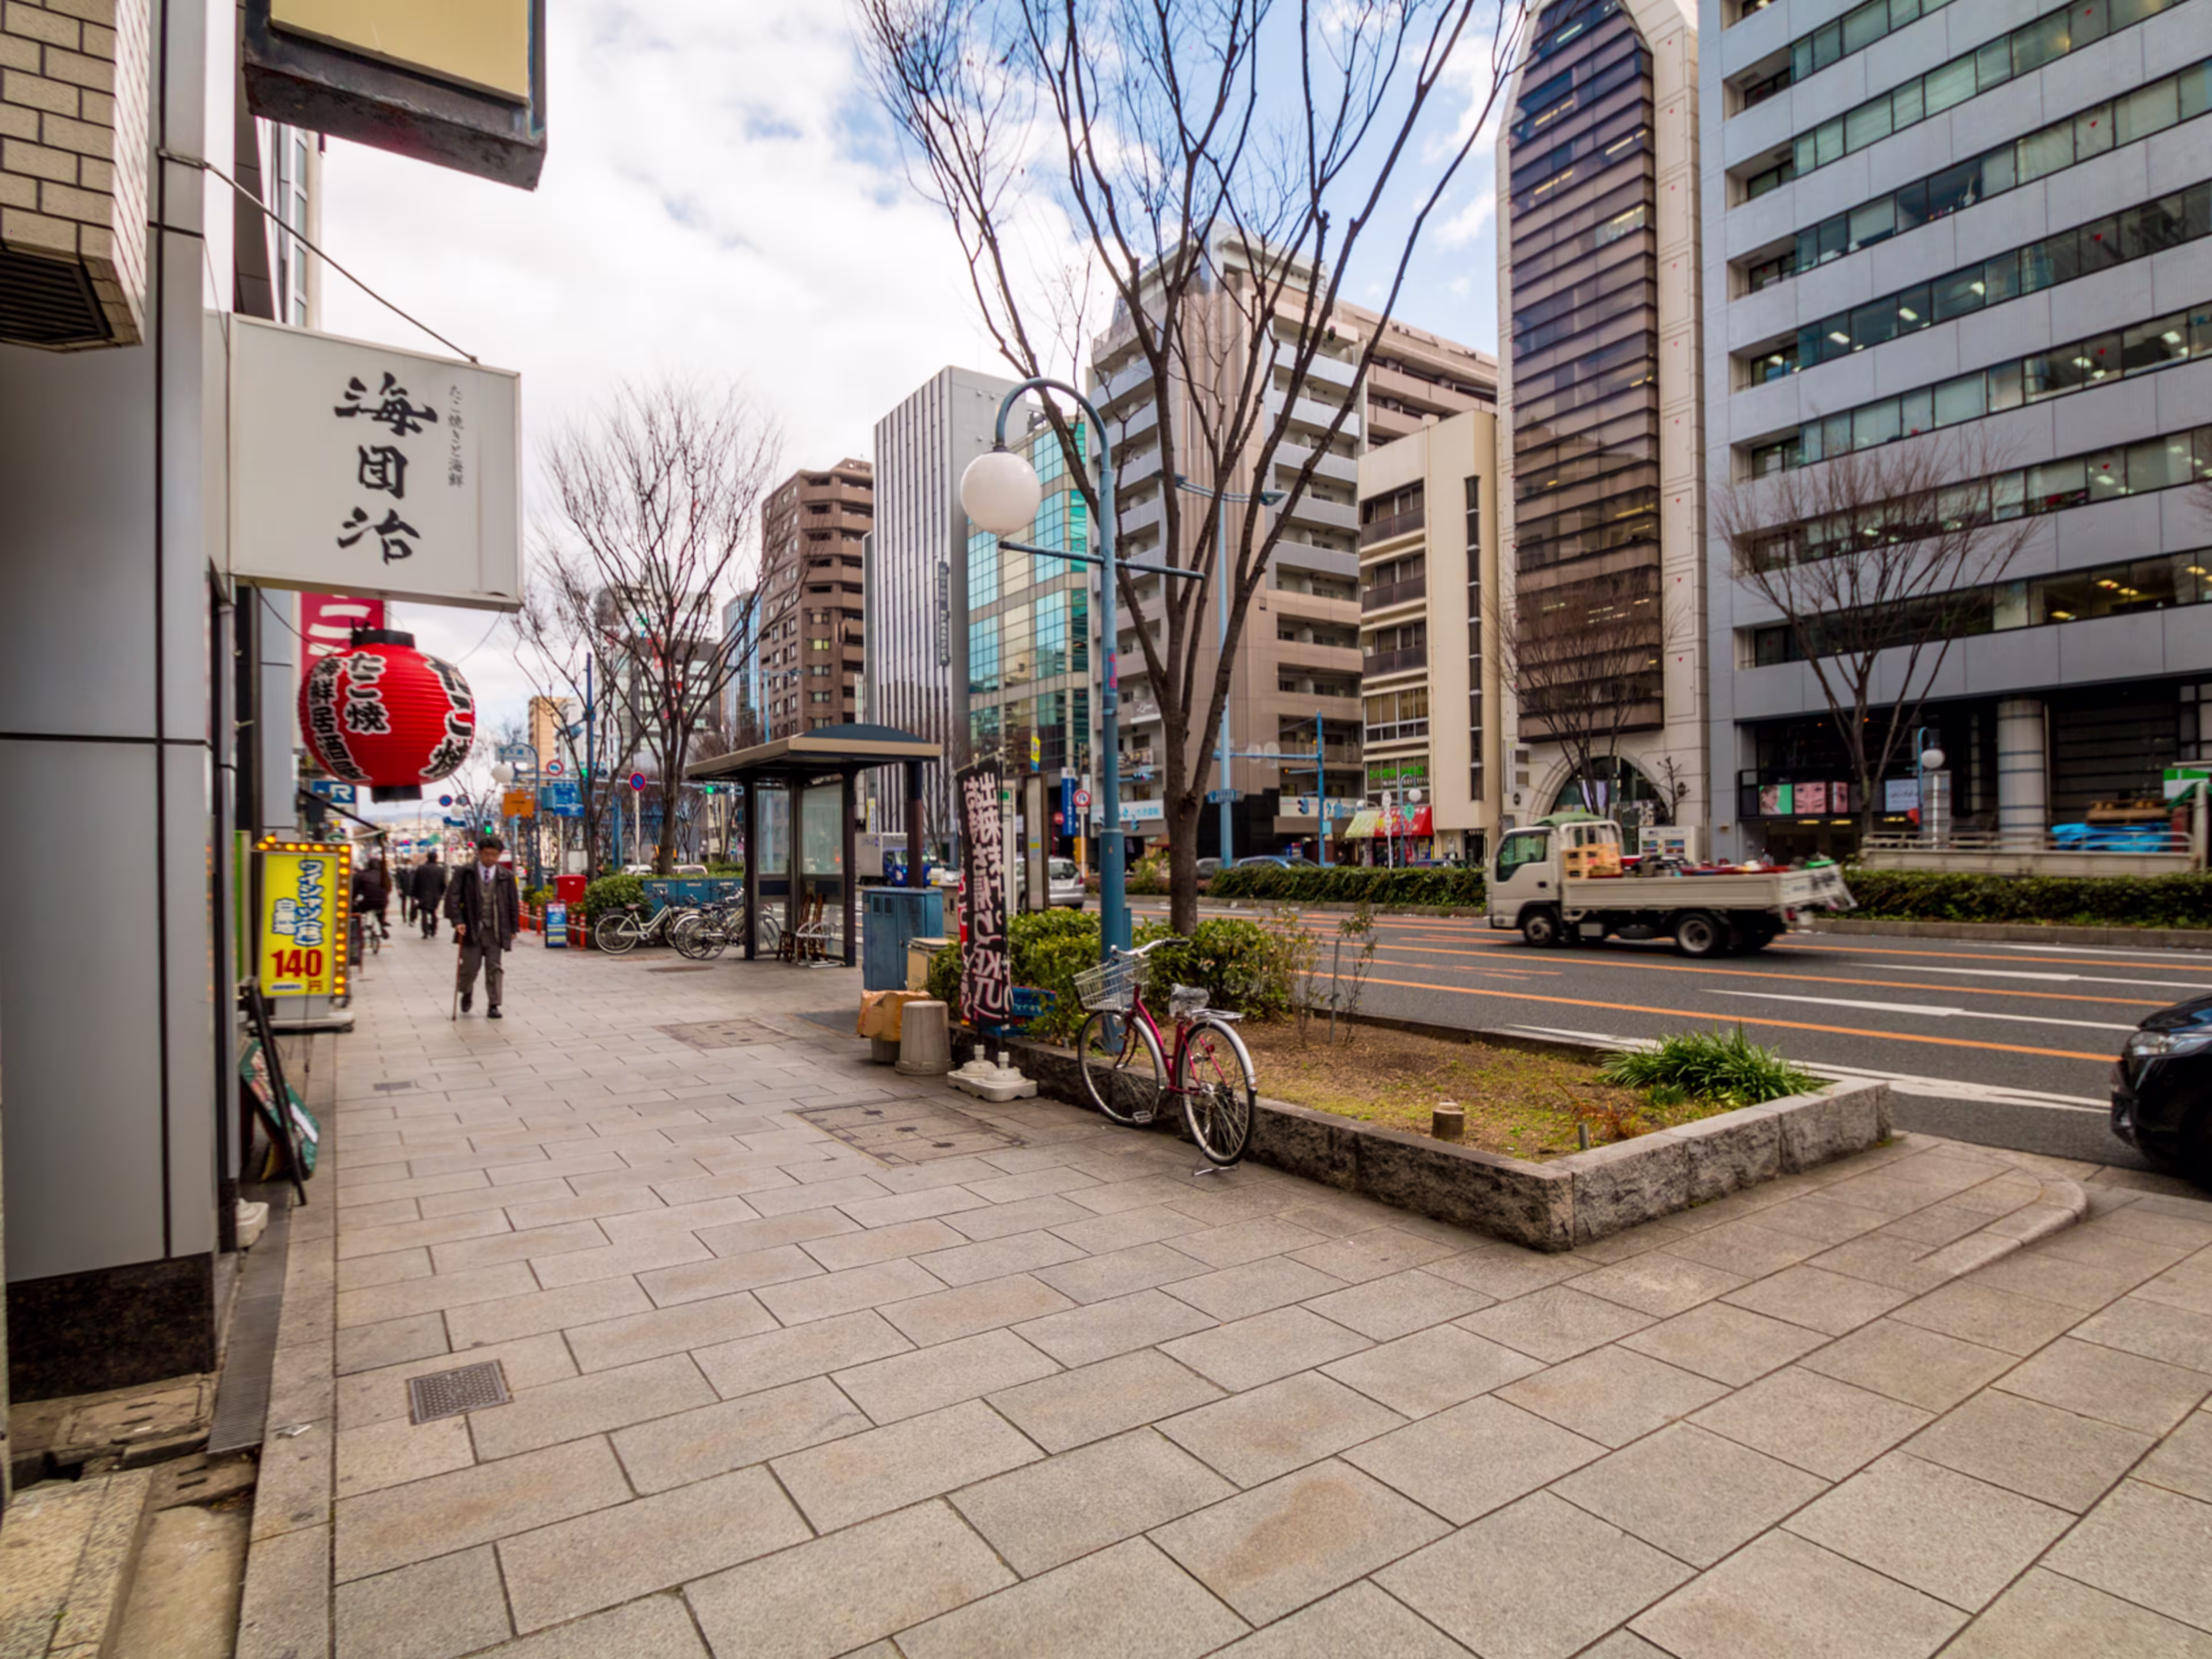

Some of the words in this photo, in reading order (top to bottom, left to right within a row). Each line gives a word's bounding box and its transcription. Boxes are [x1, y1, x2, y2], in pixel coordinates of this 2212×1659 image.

[345, 652, 390, 733] たこ焼
[270, 948, 323, 978] 140
[307, 980, 323, 993] 円
